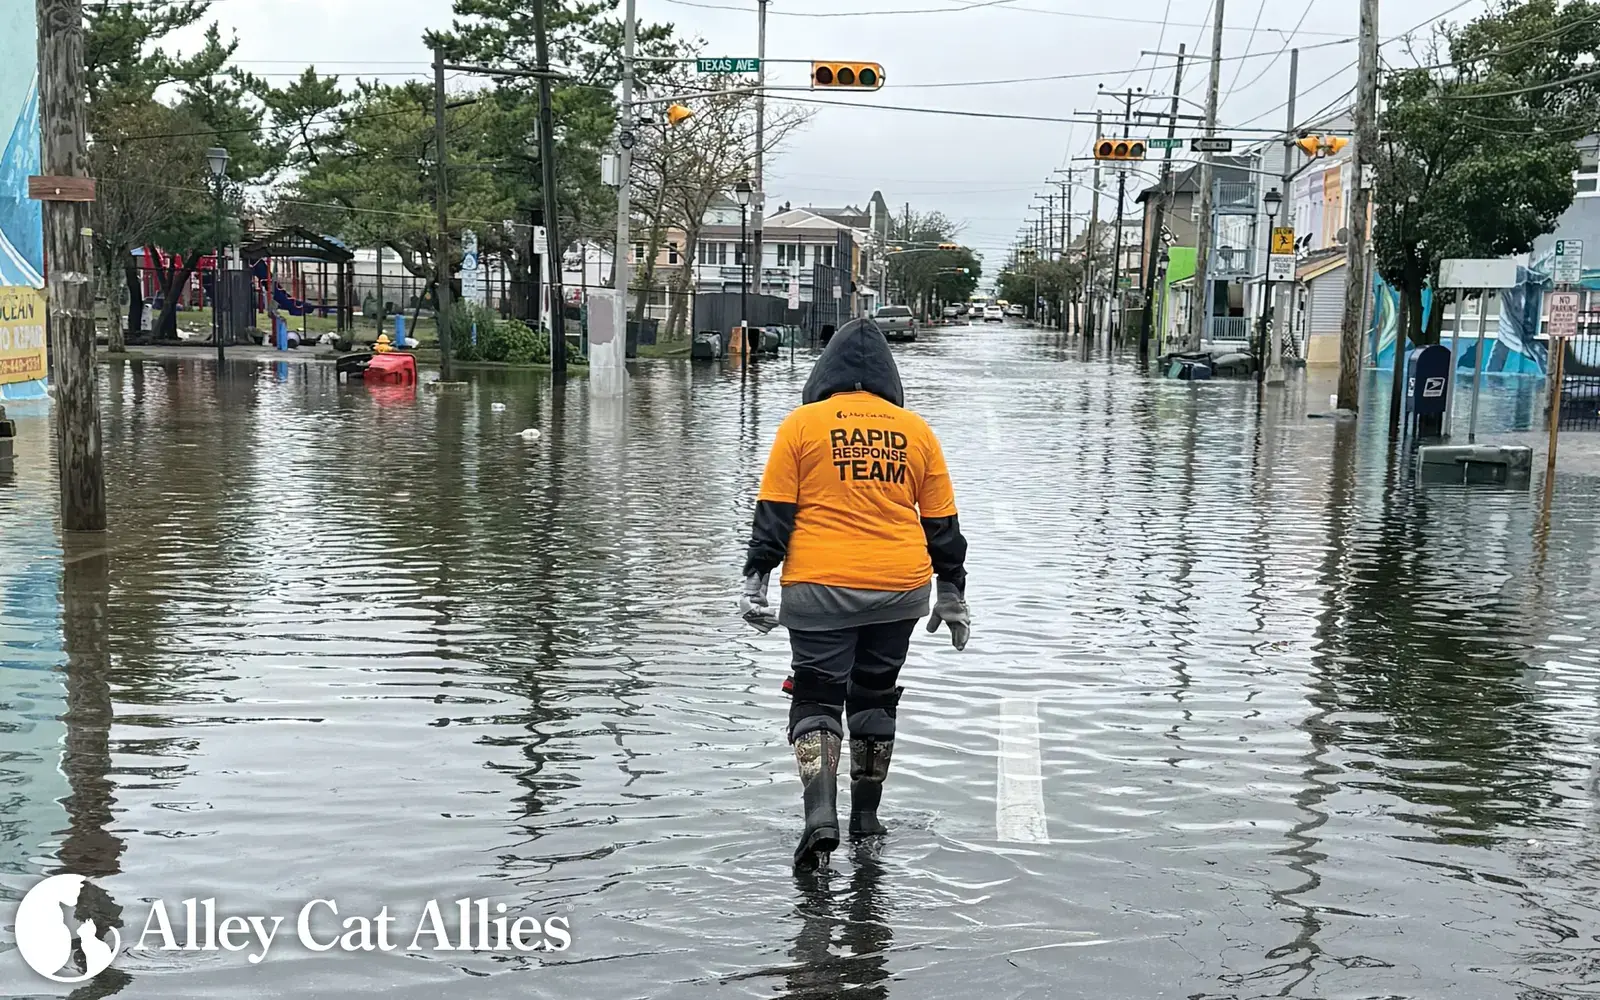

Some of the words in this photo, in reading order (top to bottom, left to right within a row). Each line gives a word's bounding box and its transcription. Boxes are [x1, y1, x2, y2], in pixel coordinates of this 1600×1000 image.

[700, 59, 732, 71] TEXAS
[1557, 241, 1563, 253] 3
[1559, 296, 1571, 305] NO
[1552, 304, 1577, 312] PARKING
[830, 428, 908, 450] RAPID
[832, 447, 907, 463] RESPONSE
[833, 460, 907, 485] TEAM
